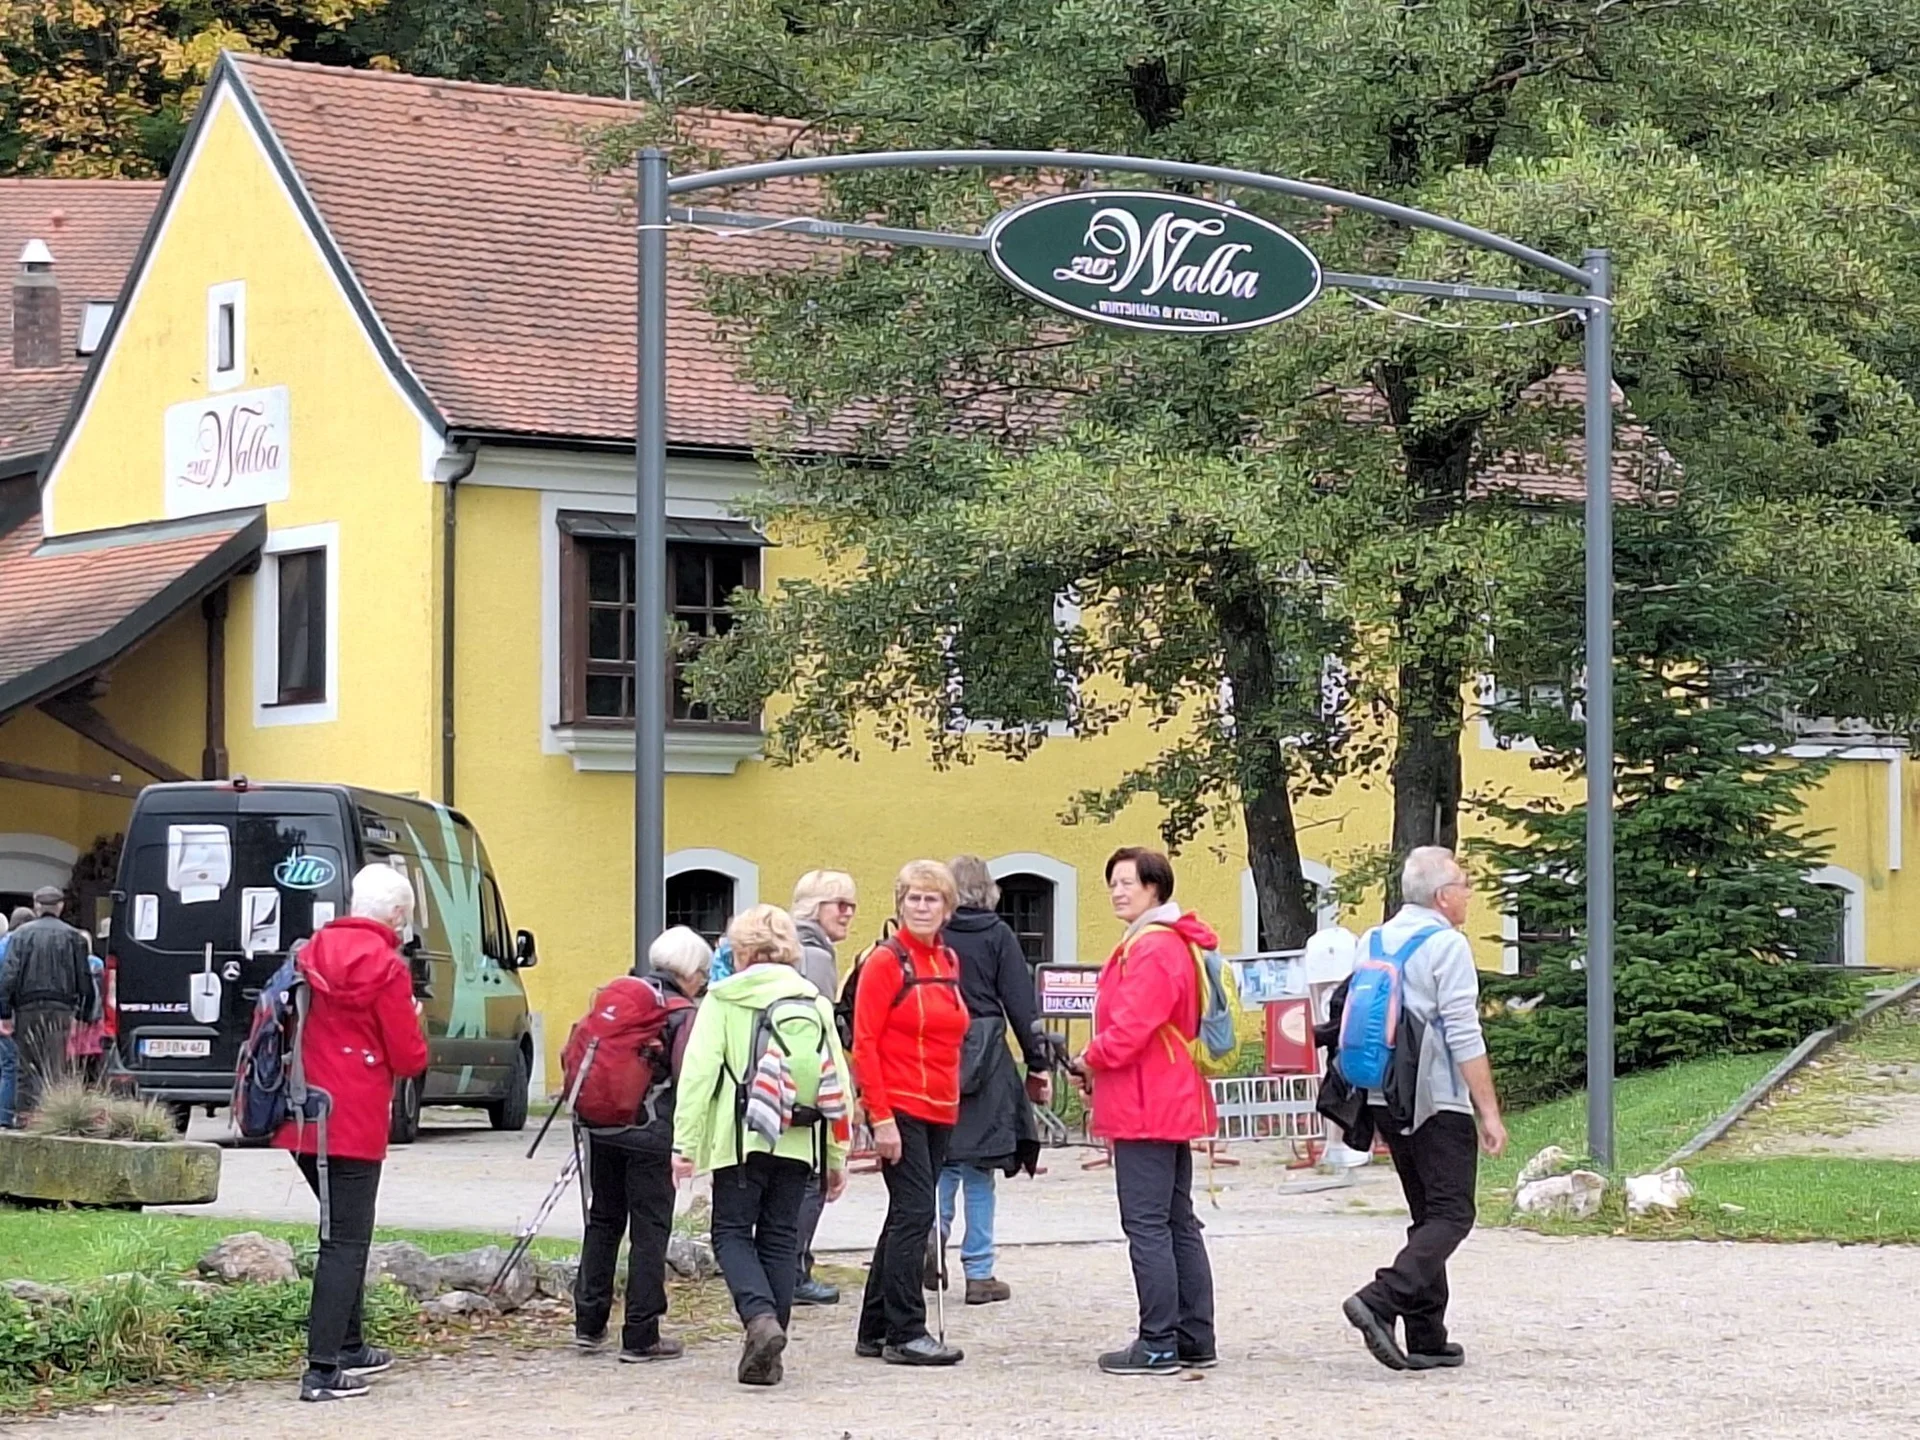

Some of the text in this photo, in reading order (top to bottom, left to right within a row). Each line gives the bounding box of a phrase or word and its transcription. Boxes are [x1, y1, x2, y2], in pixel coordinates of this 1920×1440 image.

[1054, 207, 1259, 298] zur Walba
[195, 401, 280, 489] Walba
